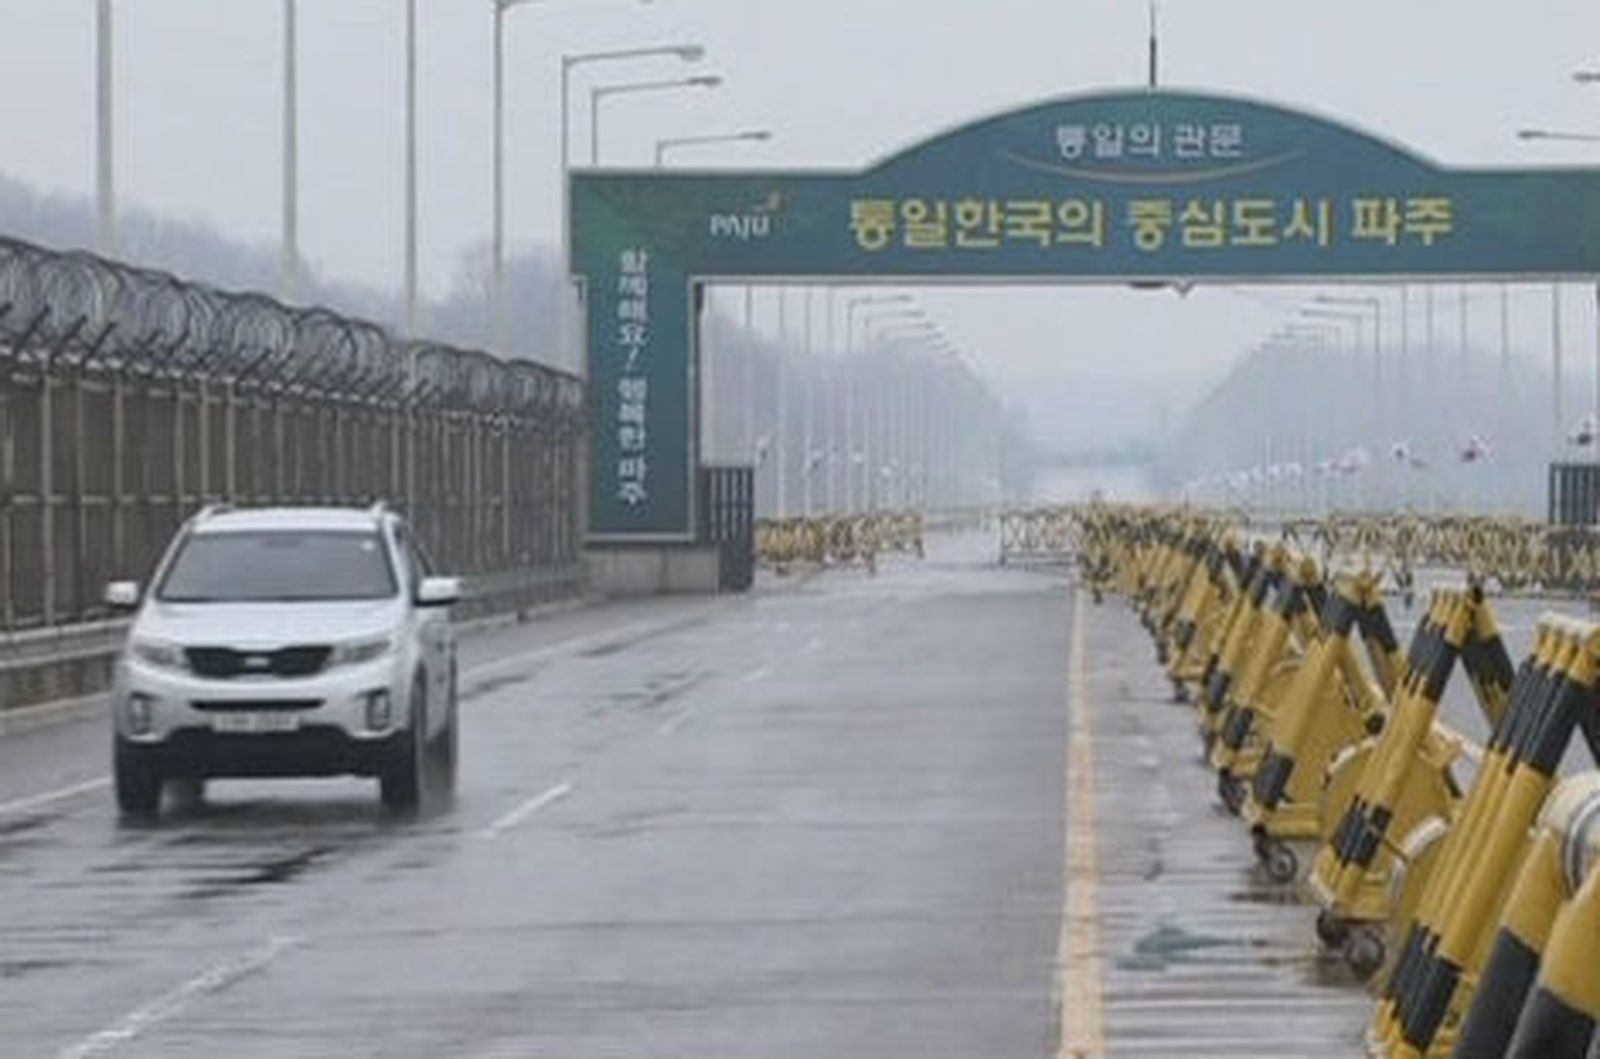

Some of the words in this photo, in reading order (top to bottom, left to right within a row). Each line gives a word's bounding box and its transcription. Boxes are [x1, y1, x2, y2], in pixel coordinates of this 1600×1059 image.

[1056, 124, 1160, 159] 통일의
[1174, 123, 1243, 159] 관문
[710, 213, 769, 240] PAJU
[849, 199, 1102, 250] 통일한국의
[1129, 199, 1329, 251] 중심도시
[1352, 198, 1452, 247] 파주
